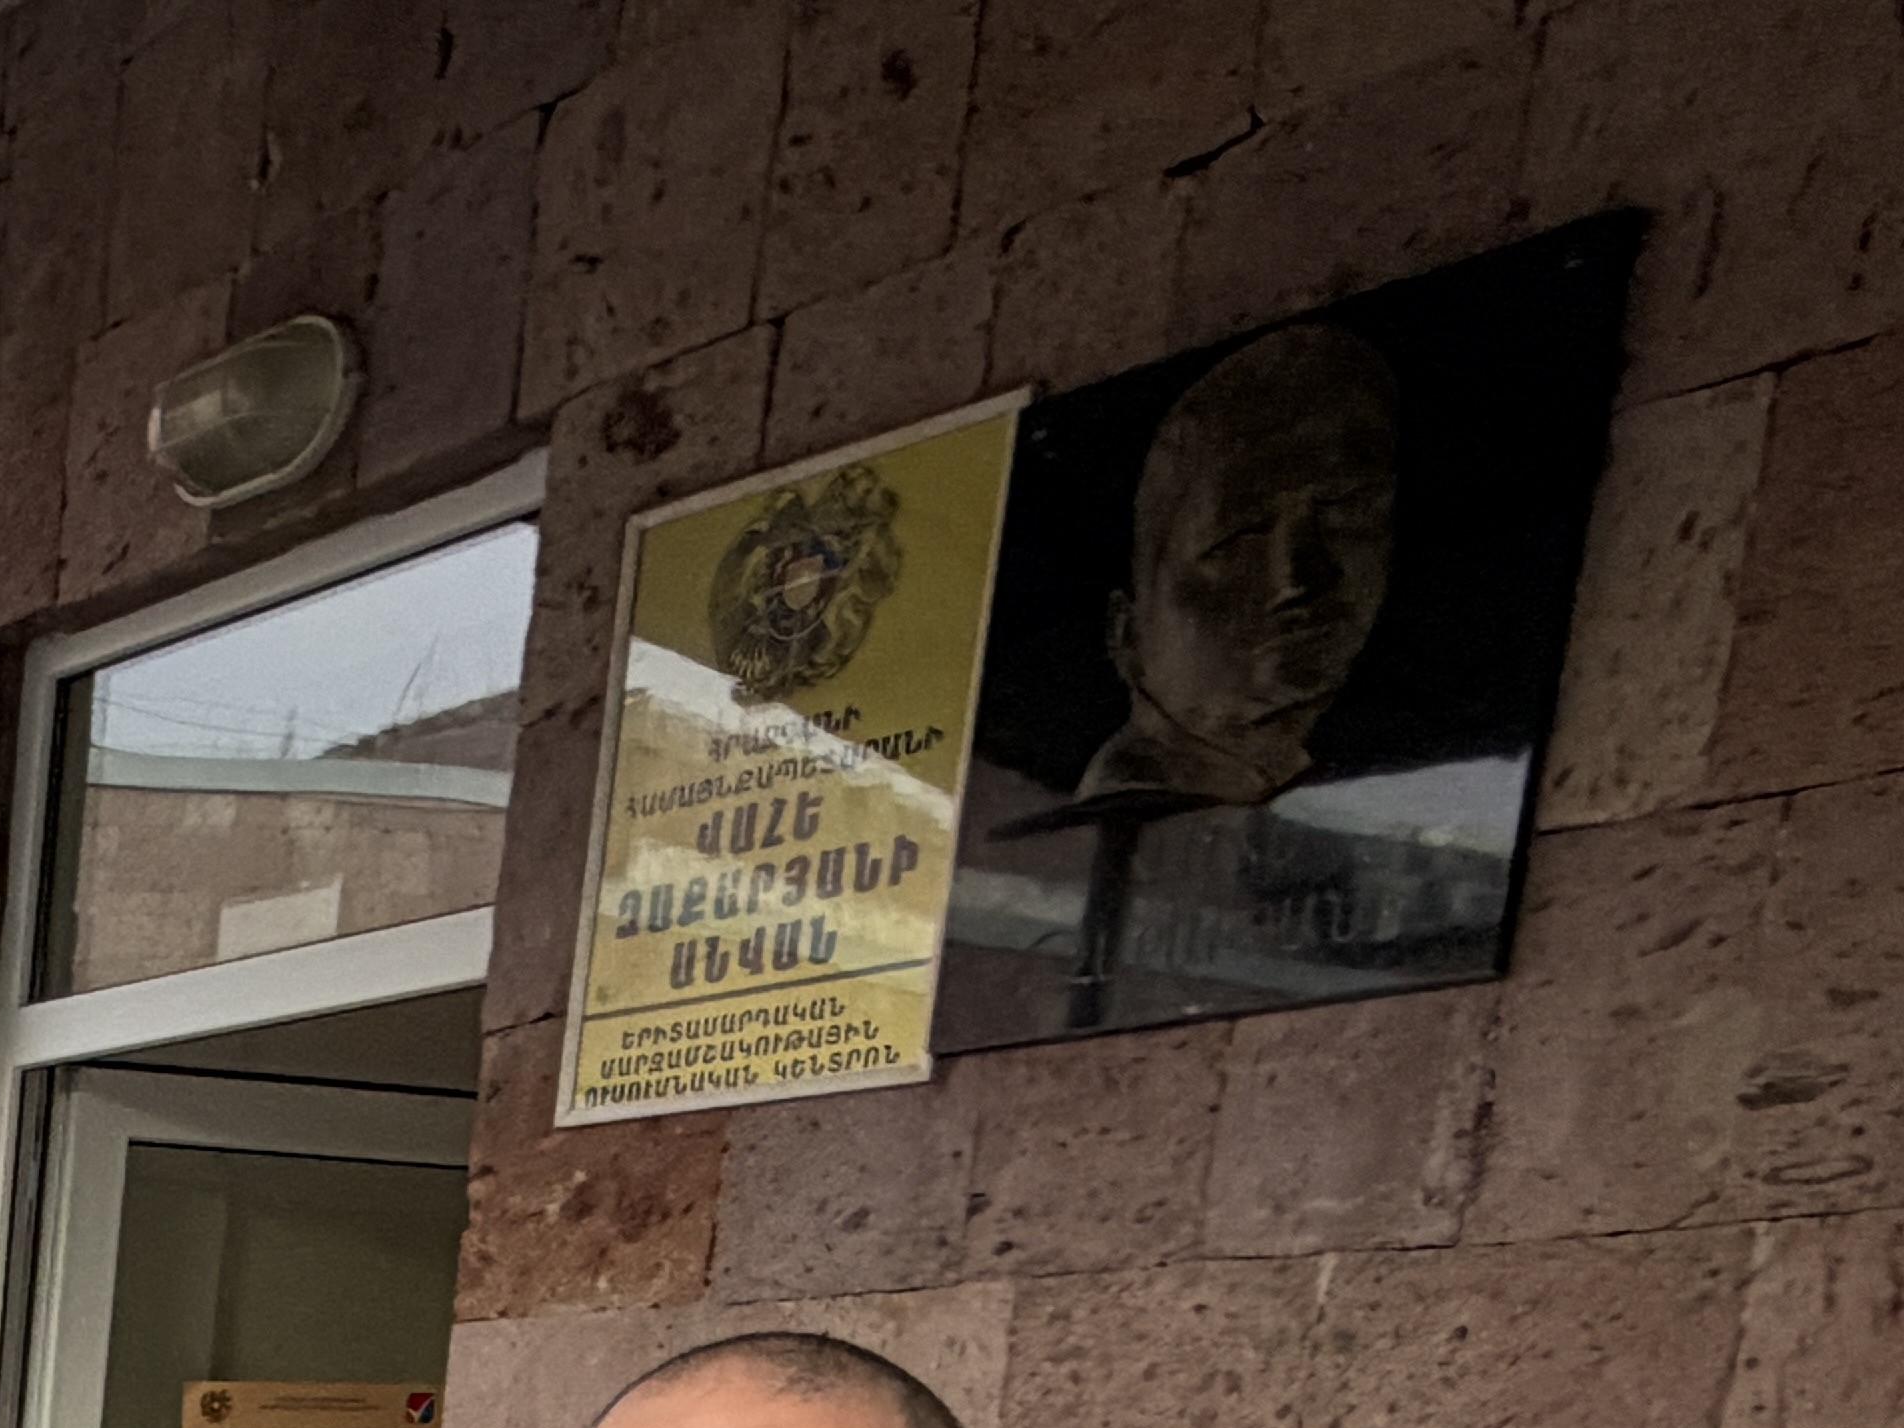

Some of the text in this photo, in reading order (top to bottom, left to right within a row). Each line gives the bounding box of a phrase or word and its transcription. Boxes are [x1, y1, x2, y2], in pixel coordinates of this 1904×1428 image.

[697, 791, 824, 857] ՎԱՀԵ
[615, 834, 919, 939] ԶԱՔԱՐՅԱՆԻ
[670, 912, 838, 989] ԱՆՎԱՆ
[774, 1045, 900, 1080] ԿԵՆՏՐՈՆ
